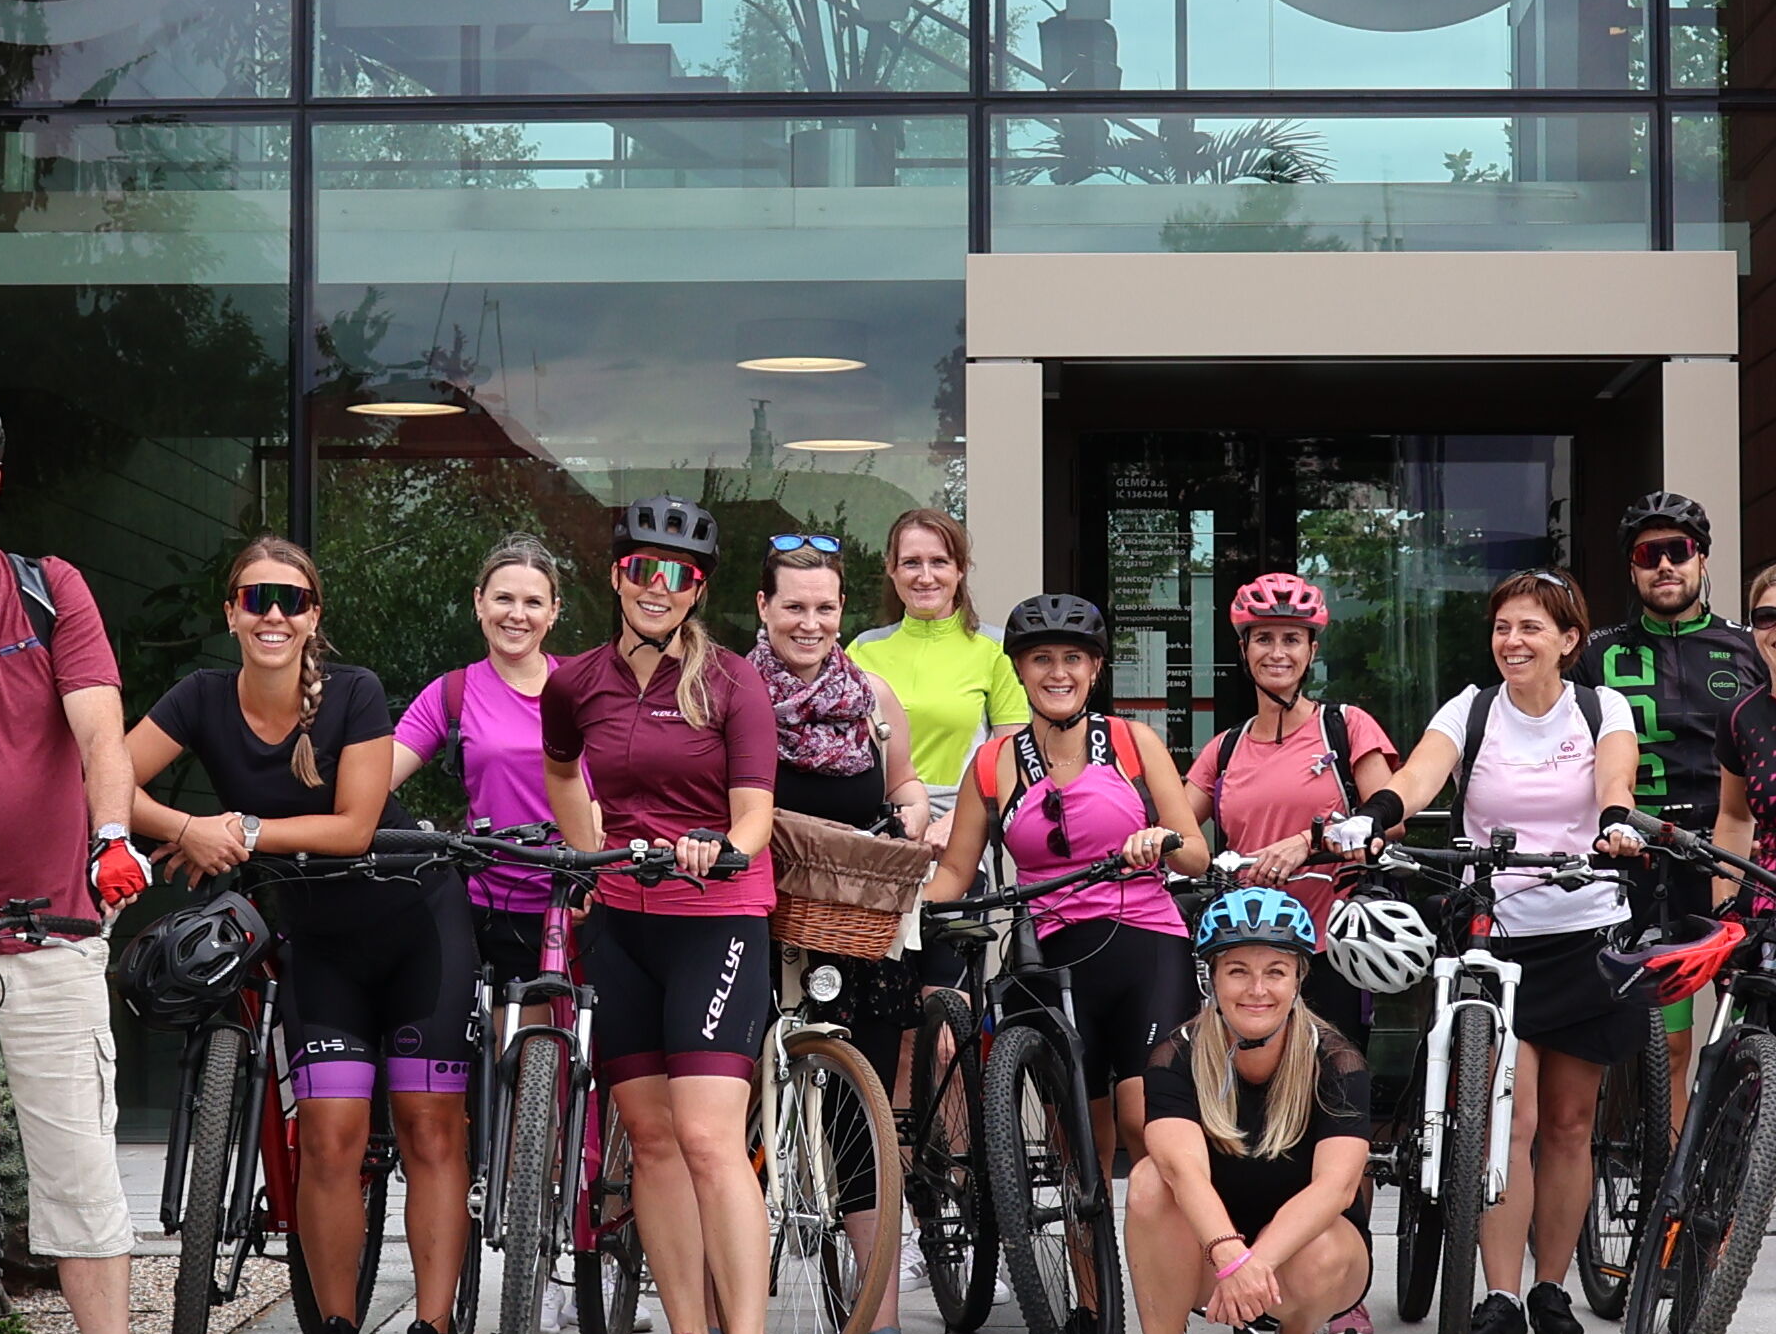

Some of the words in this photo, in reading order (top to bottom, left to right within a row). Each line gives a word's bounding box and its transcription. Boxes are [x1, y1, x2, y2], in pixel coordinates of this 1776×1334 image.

[1115, 477, 1149, 488] GEMO
[651, 709, 688, 718] KELL
[1017, 732, 1045, 782] NIKE
